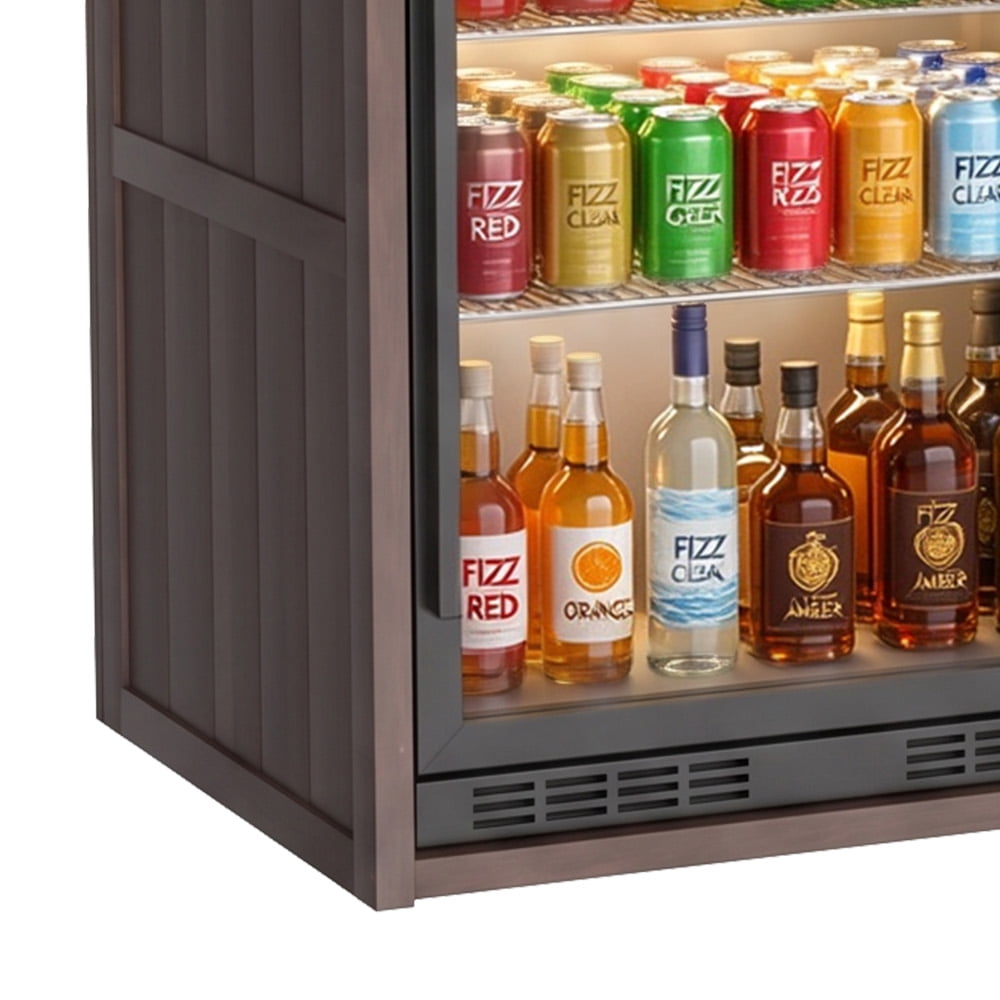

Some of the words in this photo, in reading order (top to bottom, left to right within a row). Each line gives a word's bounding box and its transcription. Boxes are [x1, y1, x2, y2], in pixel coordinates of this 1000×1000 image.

[863, 156, 912, 182] FIZZ
[468, 180, 523, 210] FIZZ
[568, 182, 618, 207] FIZZ
[471, 214, 521, 241] RED
[675, 535, 726, 560] FIZZ
[463, 556, 520, 587] FIZZ
[467, 593, 519, 620] RED
